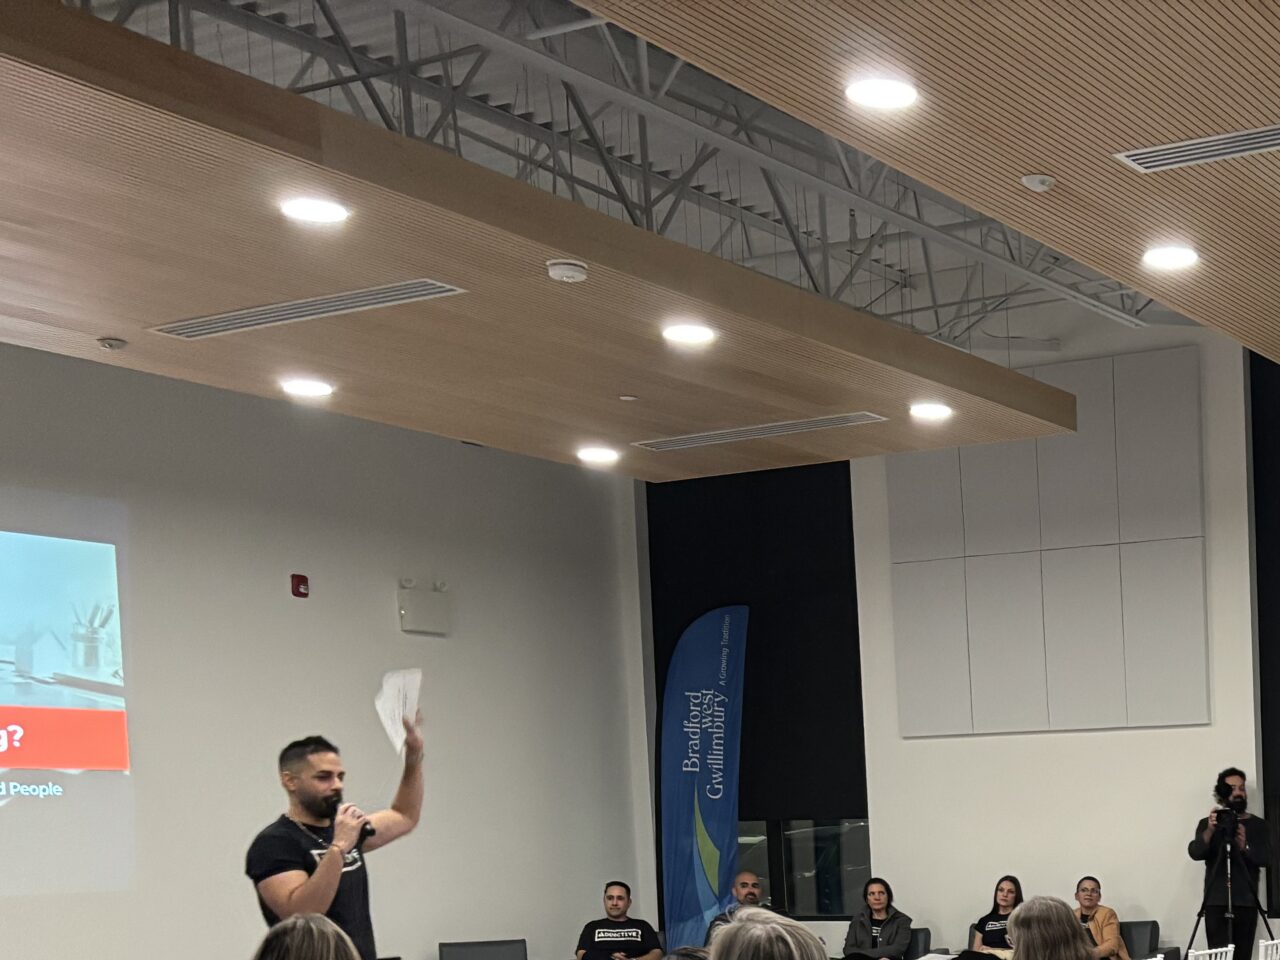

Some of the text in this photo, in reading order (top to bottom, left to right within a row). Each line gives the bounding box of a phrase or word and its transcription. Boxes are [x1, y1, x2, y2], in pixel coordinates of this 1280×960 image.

[720, 614, 731, 645] Tradition
[719, 647, 730, 678] Growing
[700, 688, 714, 728] west
[682, 691, 702, 773] Bradford
[706, 691, 728, 799] Gwillimbury
[9, 782, 63, 798] People
